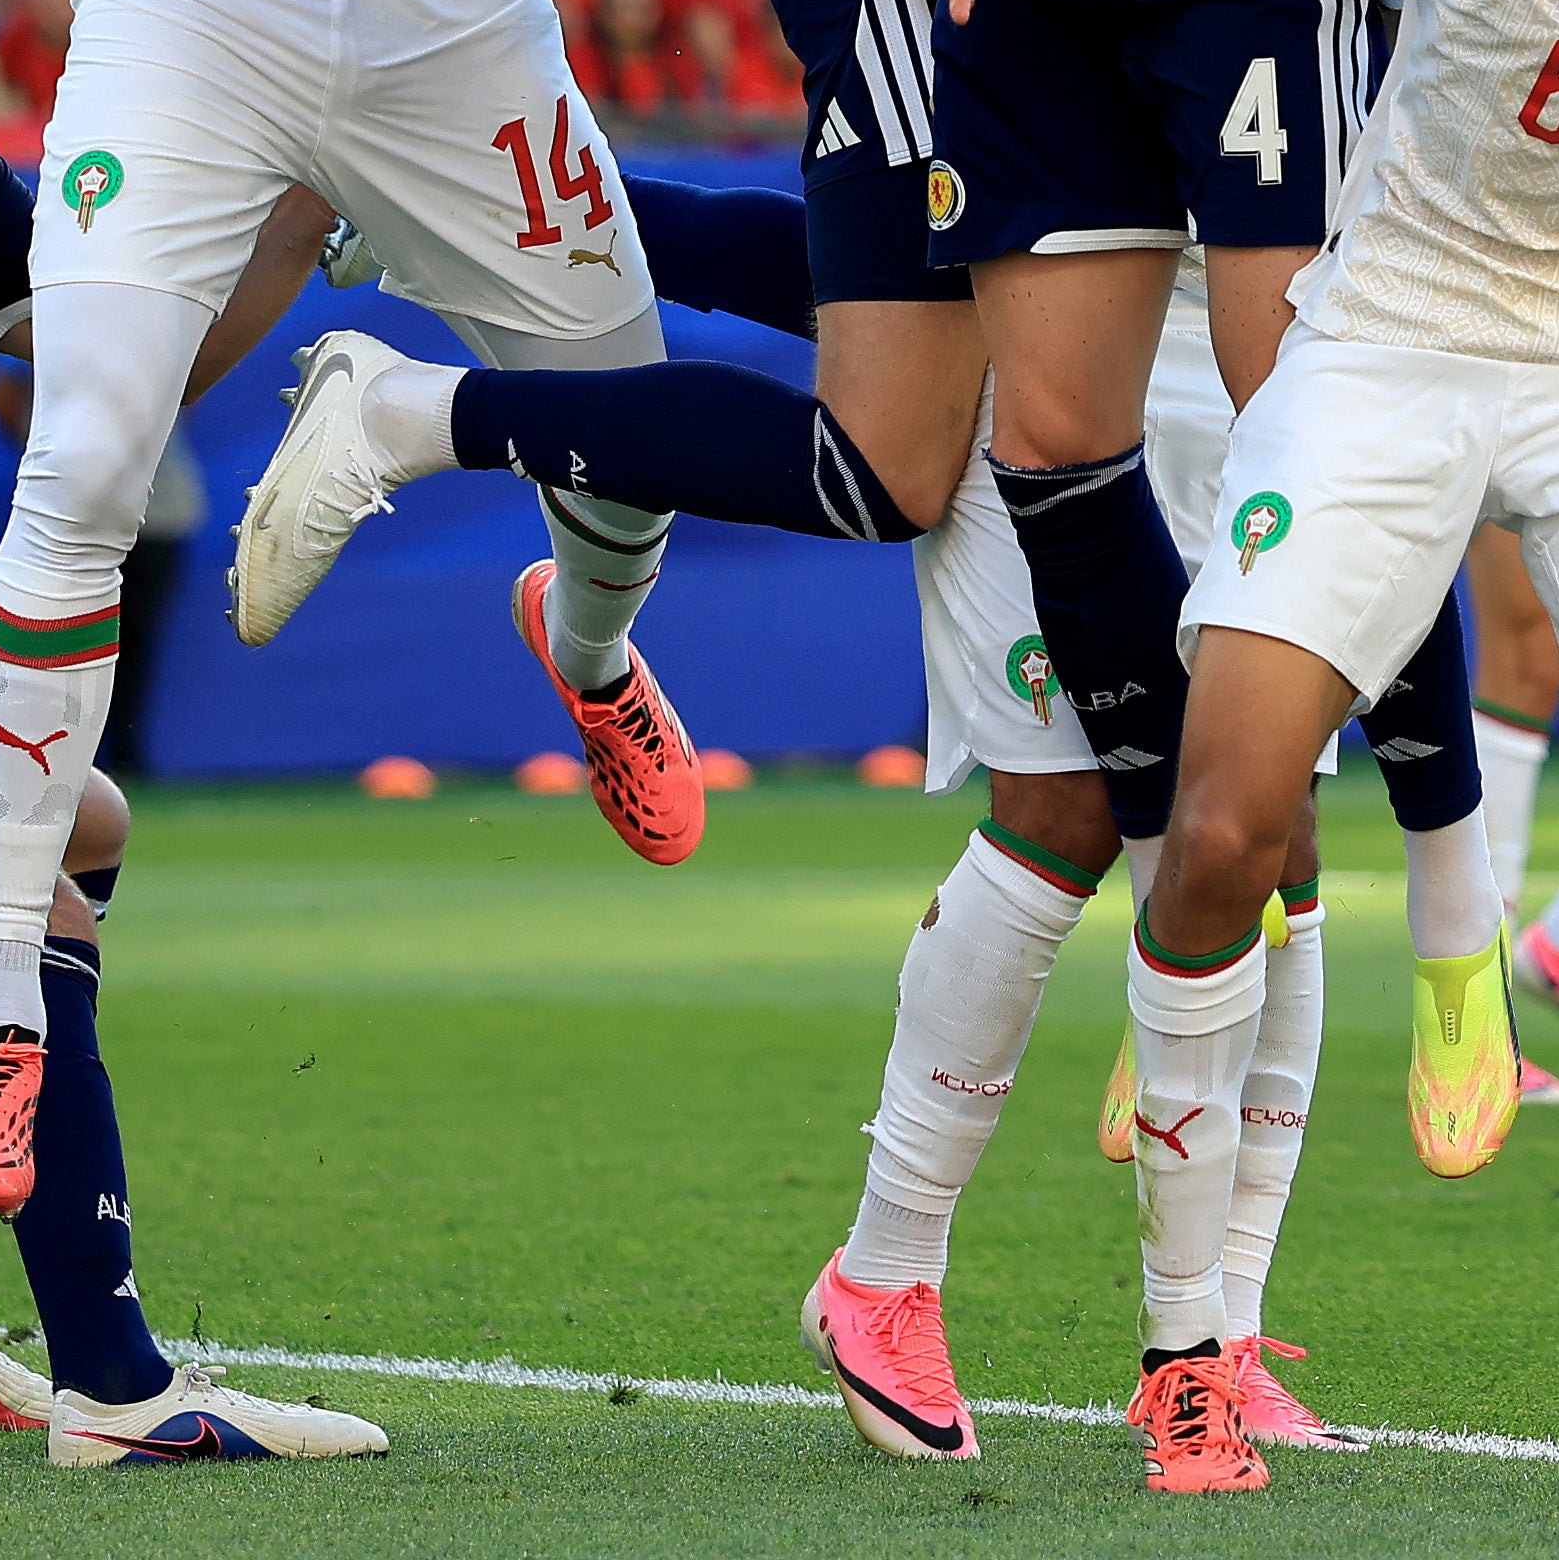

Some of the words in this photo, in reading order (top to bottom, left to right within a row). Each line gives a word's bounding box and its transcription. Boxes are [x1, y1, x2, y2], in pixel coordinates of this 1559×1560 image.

[1220, 57, 1288, 185] 4
[490, 93, 615, 250] 14
[568, 449, 596, 499] AL
[1066, 680, 1147, 711] LBA
